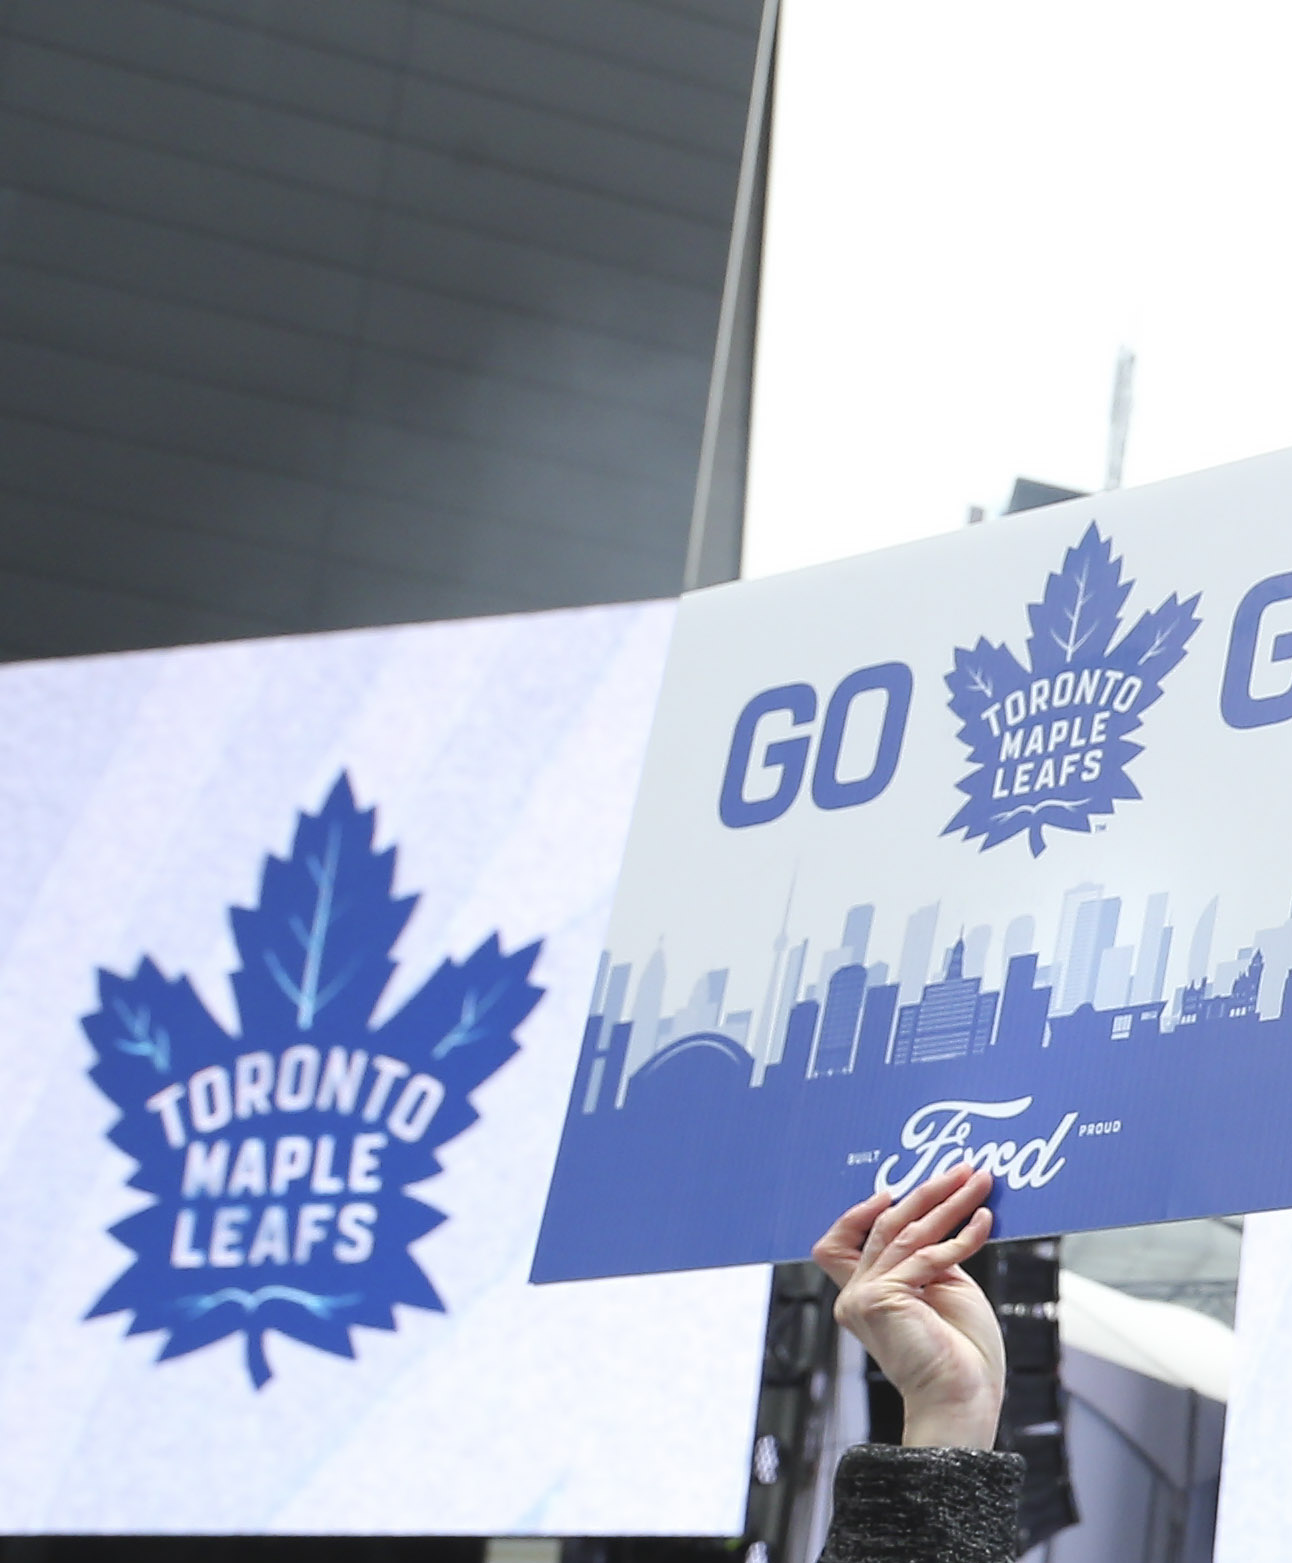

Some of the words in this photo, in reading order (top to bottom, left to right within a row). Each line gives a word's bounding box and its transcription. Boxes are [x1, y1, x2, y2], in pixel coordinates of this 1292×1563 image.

[980, 668, 1143, 737] TORONTO
[1000, 710, 1111, 762] MAPLE
[719, 661, 913, 828] GO
[992, 749, 1103, 799] LEAFS
[145, 1044, 446, 1150] TORONTO
[180, 1132, 390, 1200] MAPLE
[874, 1096, 1079, 1201] Ford
[1079, 1119, 1122, 1137] PROUD
[171, 1203, 380, 1269] LEAFS
